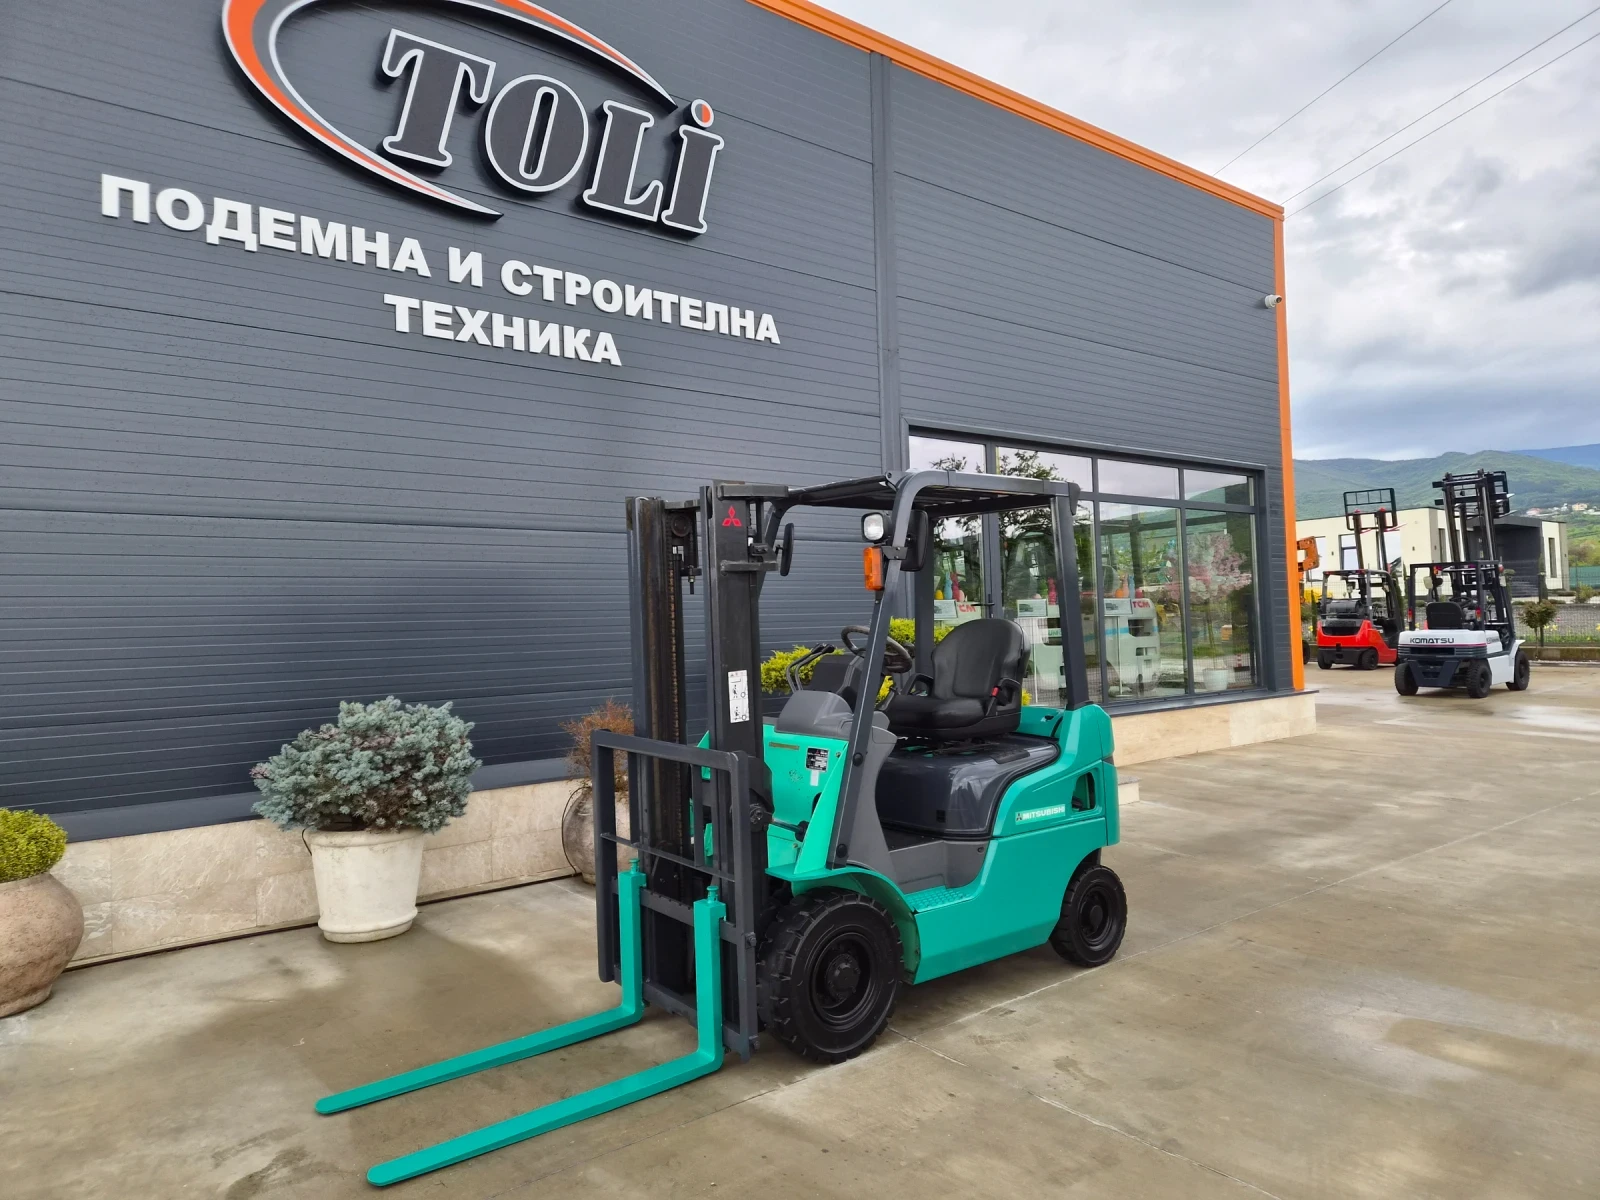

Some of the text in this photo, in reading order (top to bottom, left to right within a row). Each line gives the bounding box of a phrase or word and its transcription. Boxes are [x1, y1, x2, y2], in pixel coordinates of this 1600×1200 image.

[100, 173, 781, 345] ПОДЕМНА И СТРОИТЕЛНА
[383, 293, 622, 367] ТЕХНИКА
[1022, 806, 1065, 820] MITSUBISHI
